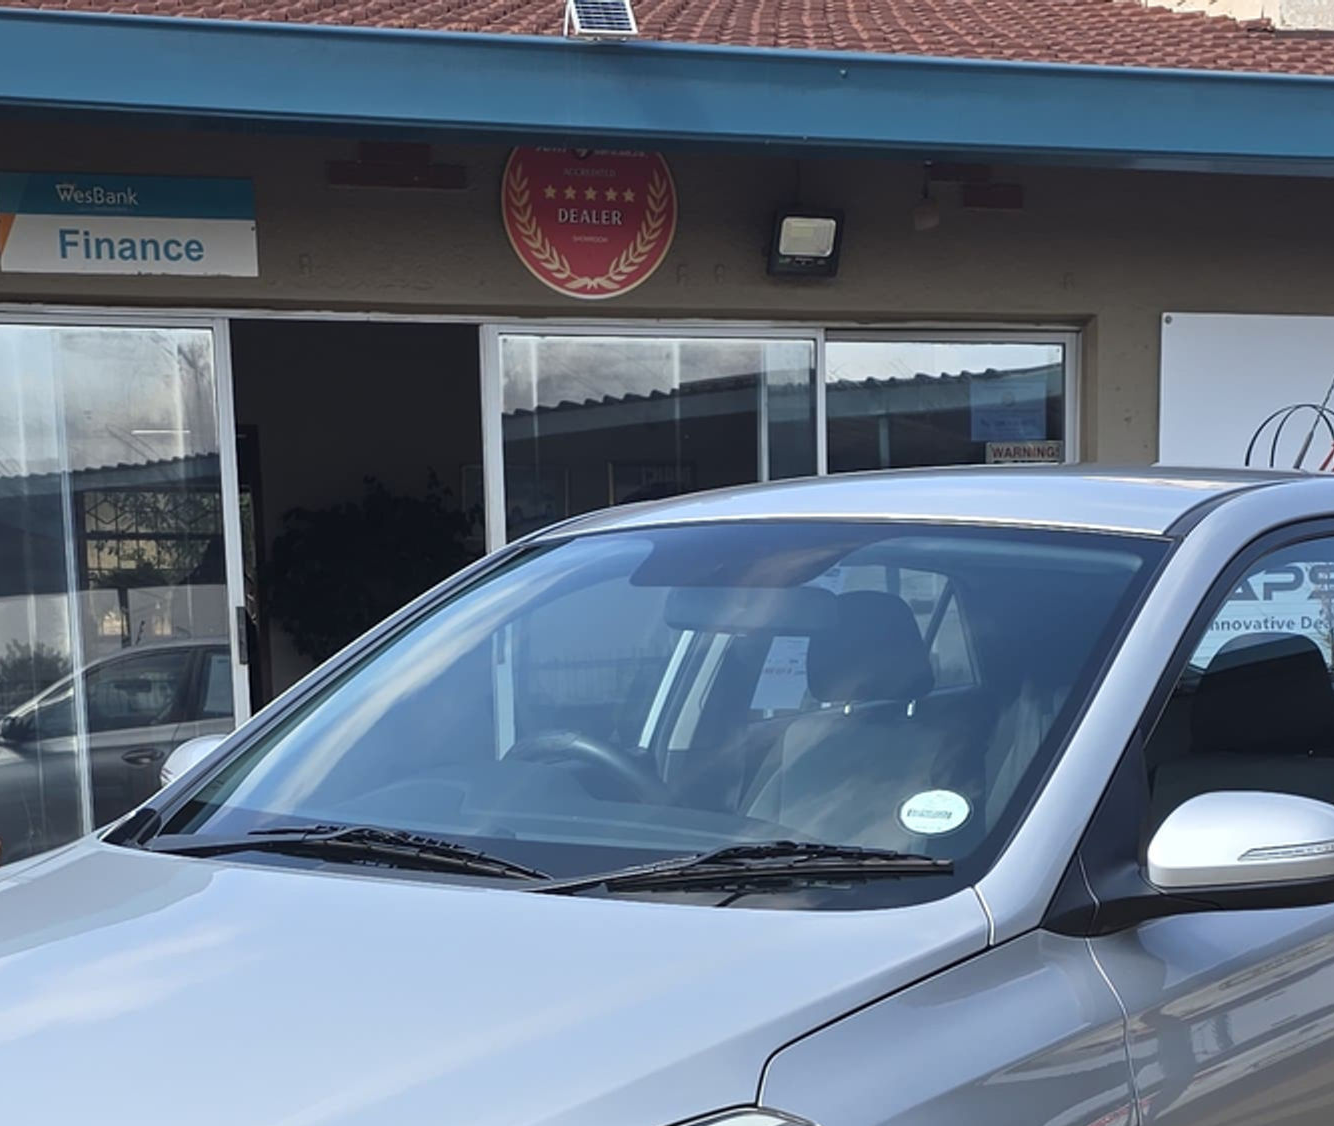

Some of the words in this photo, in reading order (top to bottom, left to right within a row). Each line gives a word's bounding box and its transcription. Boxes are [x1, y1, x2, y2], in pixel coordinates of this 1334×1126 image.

[55, 184, 138, 205] WesBank
[558, 208, 623, 225] DEALER
[59, 229, 204, 261] Finance
